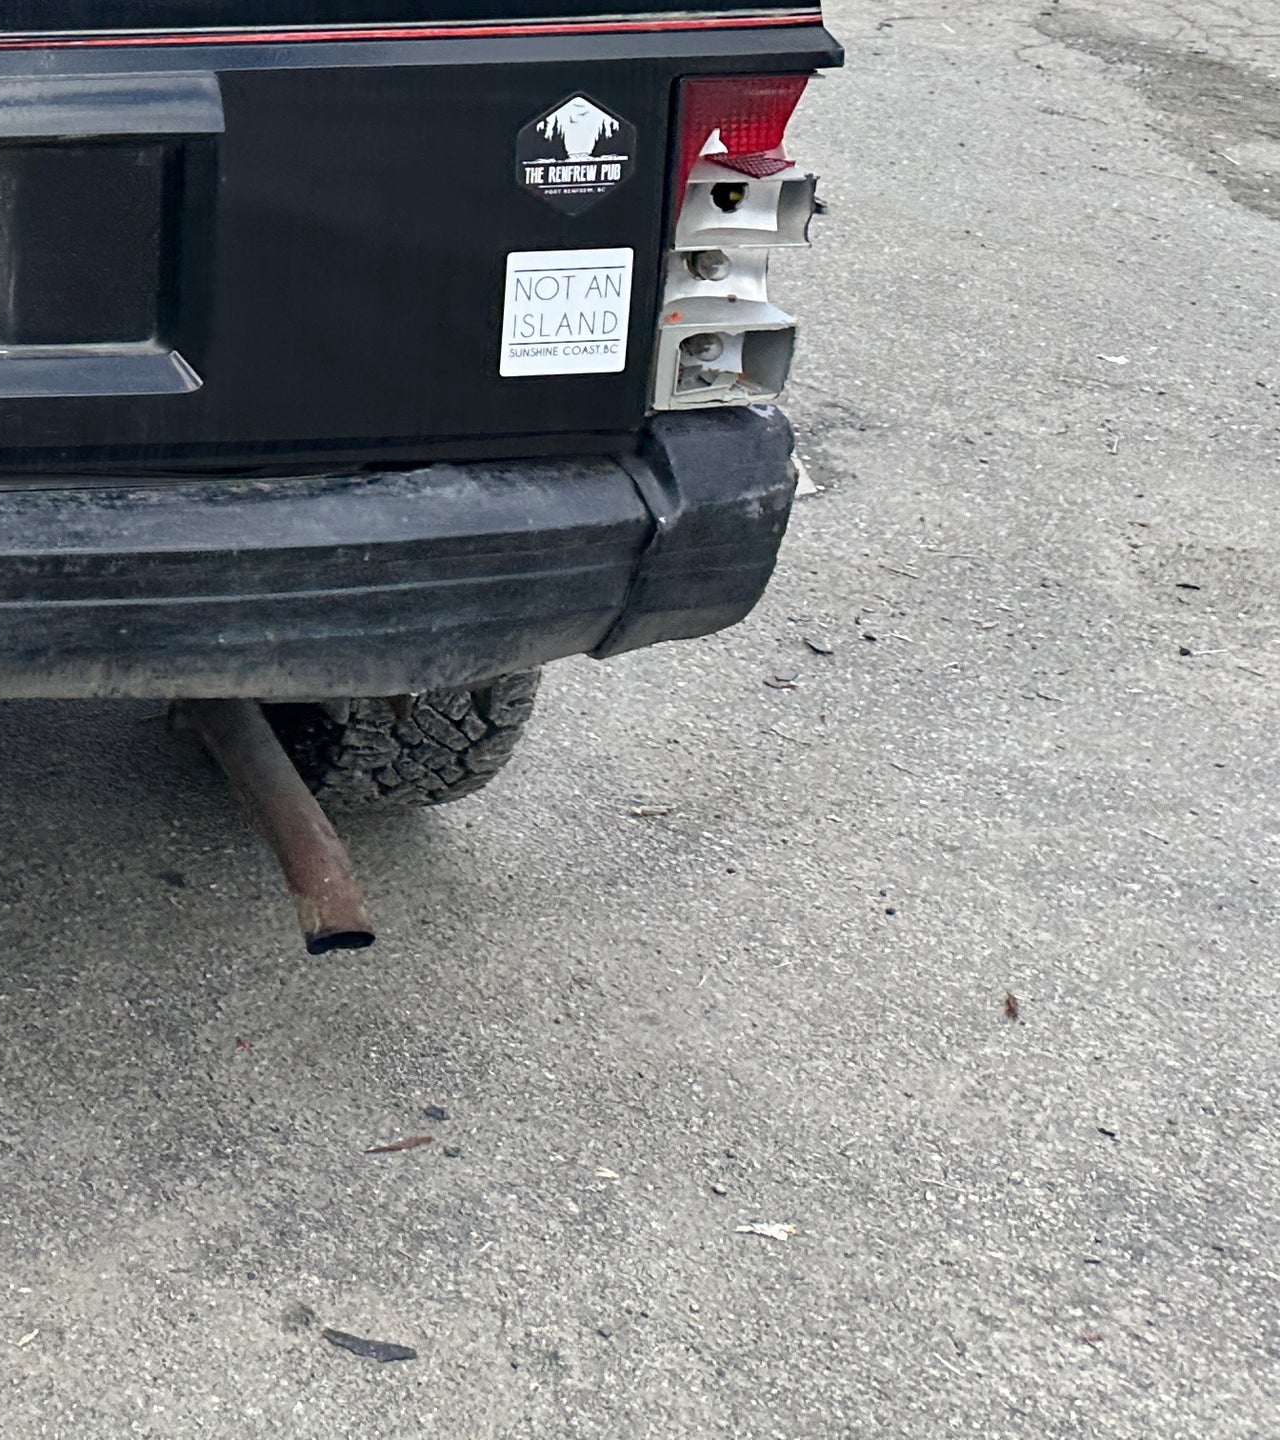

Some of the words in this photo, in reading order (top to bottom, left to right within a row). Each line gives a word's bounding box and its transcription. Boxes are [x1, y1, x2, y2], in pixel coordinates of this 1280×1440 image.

[525, 167, 544, 184] THE
[548, 164, 597, 183] RENFREW
[601, 163, 621, 180] PUB
[515, 275, 576, 302] NOT
[585, 273, 622, 299] AN
[512, 310, 618, 339] ISLAND
[508, 346, 559, 358] SUNSHINE
